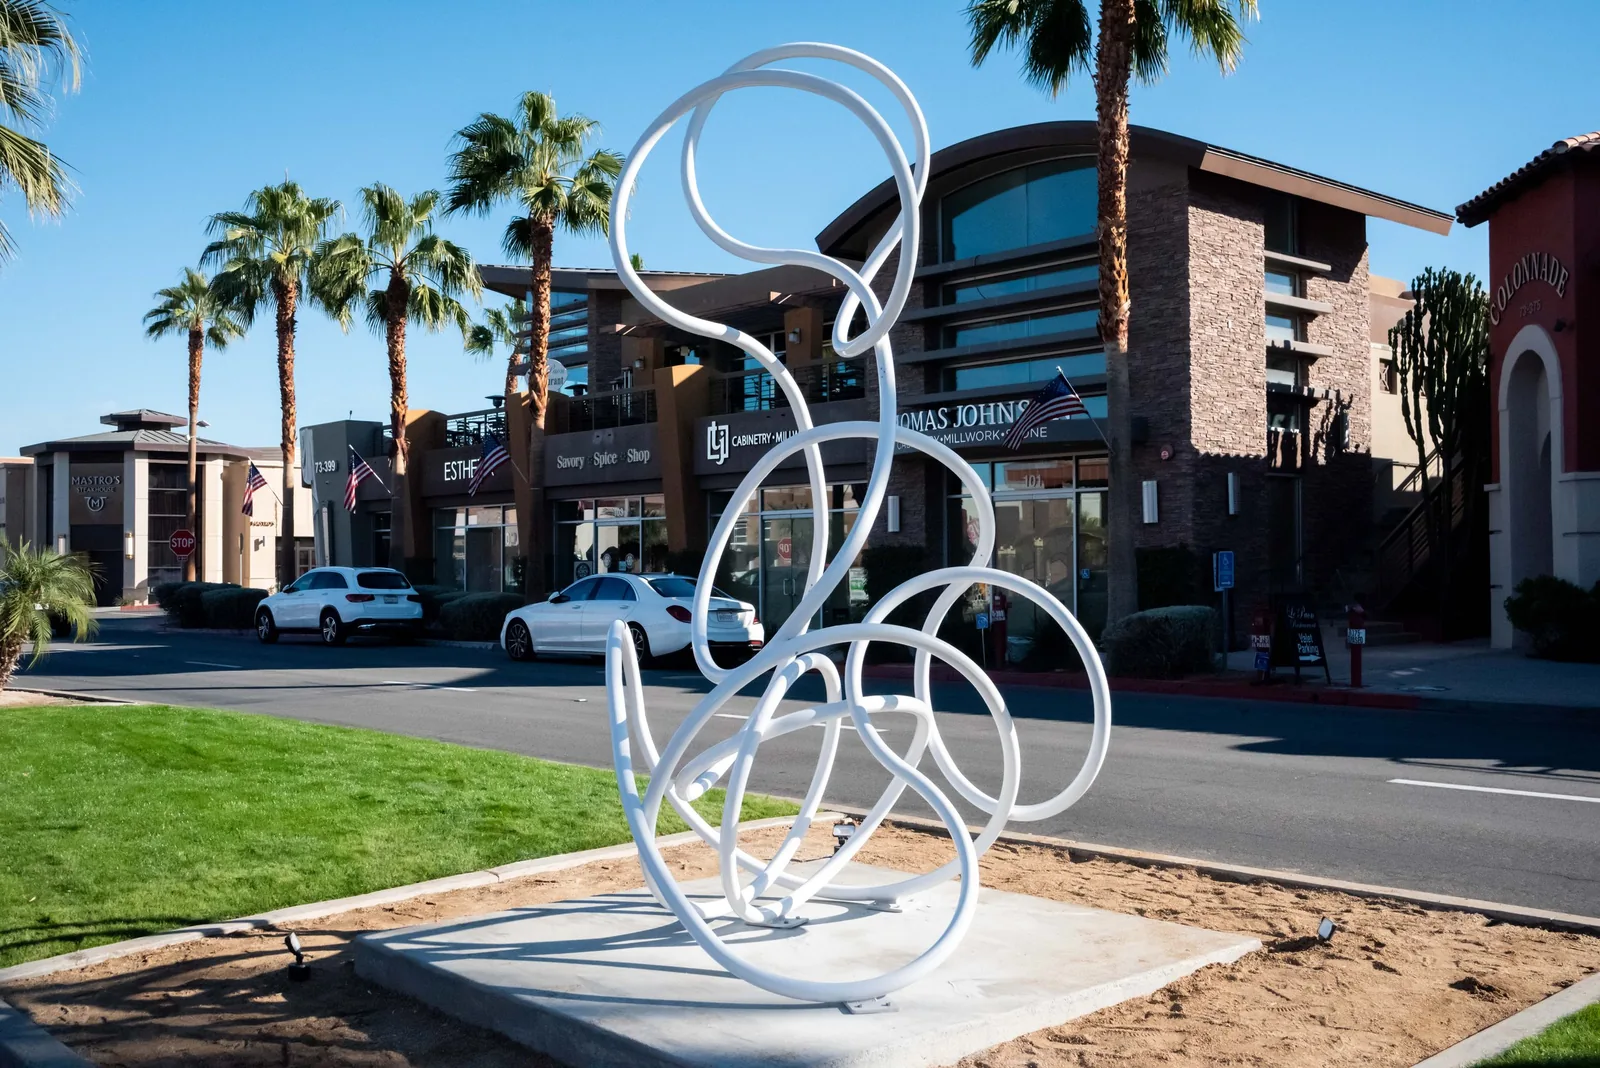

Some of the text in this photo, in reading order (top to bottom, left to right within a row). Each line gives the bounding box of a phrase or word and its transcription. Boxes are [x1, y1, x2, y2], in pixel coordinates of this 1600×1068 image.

[1490, 252, 1569, 325] COLONNADE
[1520, 300, 1541, 317] 73-375
[896, 399, 1071, 432] OMAS JOHNS
[731, 432, 772, 447] CABINETRY
[943, 429, 1000, 444] MILLWORK
[315, 460, 336, 473] 73-399
[556, 448, 650, 470] Savory Spice Shop
[444, 459, 494, 481] ESTHE
[72, 475, 120, 485] MASTRO'S
[1023, 474, 1042, 488] 101
[171, 537, 194, 548] STOP
[1298, 632, 1314, 644] Valet
[1297, 643, 1320, 656] Parking
